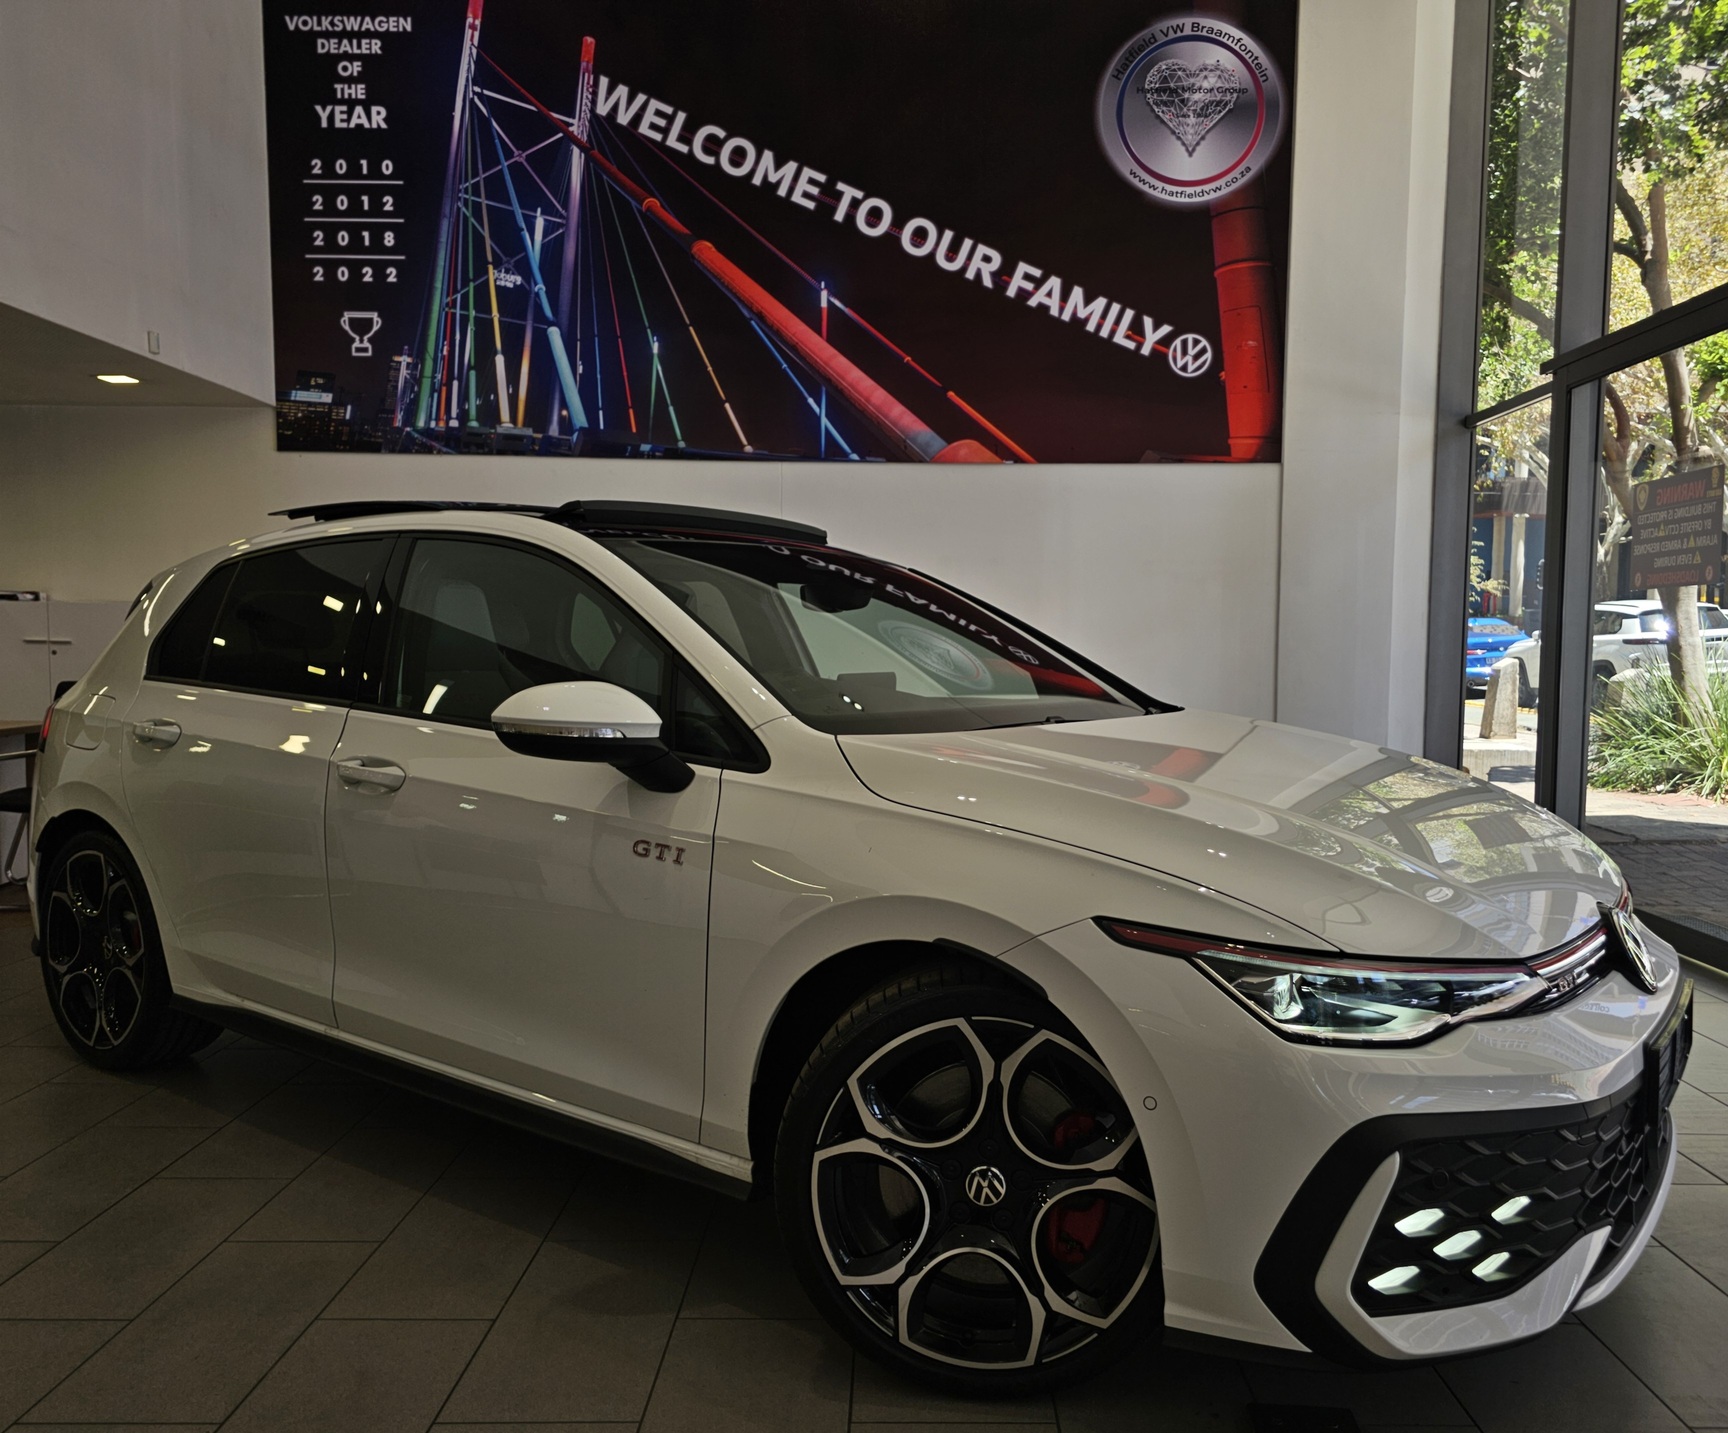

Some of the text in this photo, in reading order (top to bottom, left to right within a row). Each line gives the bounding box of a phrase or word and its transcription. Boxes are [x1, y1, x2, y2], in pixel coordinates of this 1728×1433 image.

[285, 15, 412, 32] VOLKSWAGEN
[317, 39, 382, 54] DEALER
[1112, 22, 1269, 83] Hatfield VW Braamfontein
[337, 61, 362, 76] OF
[334, 84, 366, 99] THE
[1182, 86, 1214, 94] Motor
[1216, 86, 1248, 95] Group
[314, 105, 388, 129] YEAR
[311, 159, 393, 175] 2010
[1129, 165, 1252, 199] www.hatfieldvw.co.za
[312, 195, 394, 210] 2012
[595, 75, 1174, 357] WELCOME TO OUR FAMILY
[313, 231, 395, 246] 2018
[313, 266, 397, 282] 2022
[633, 839, 686, 866] GTI
